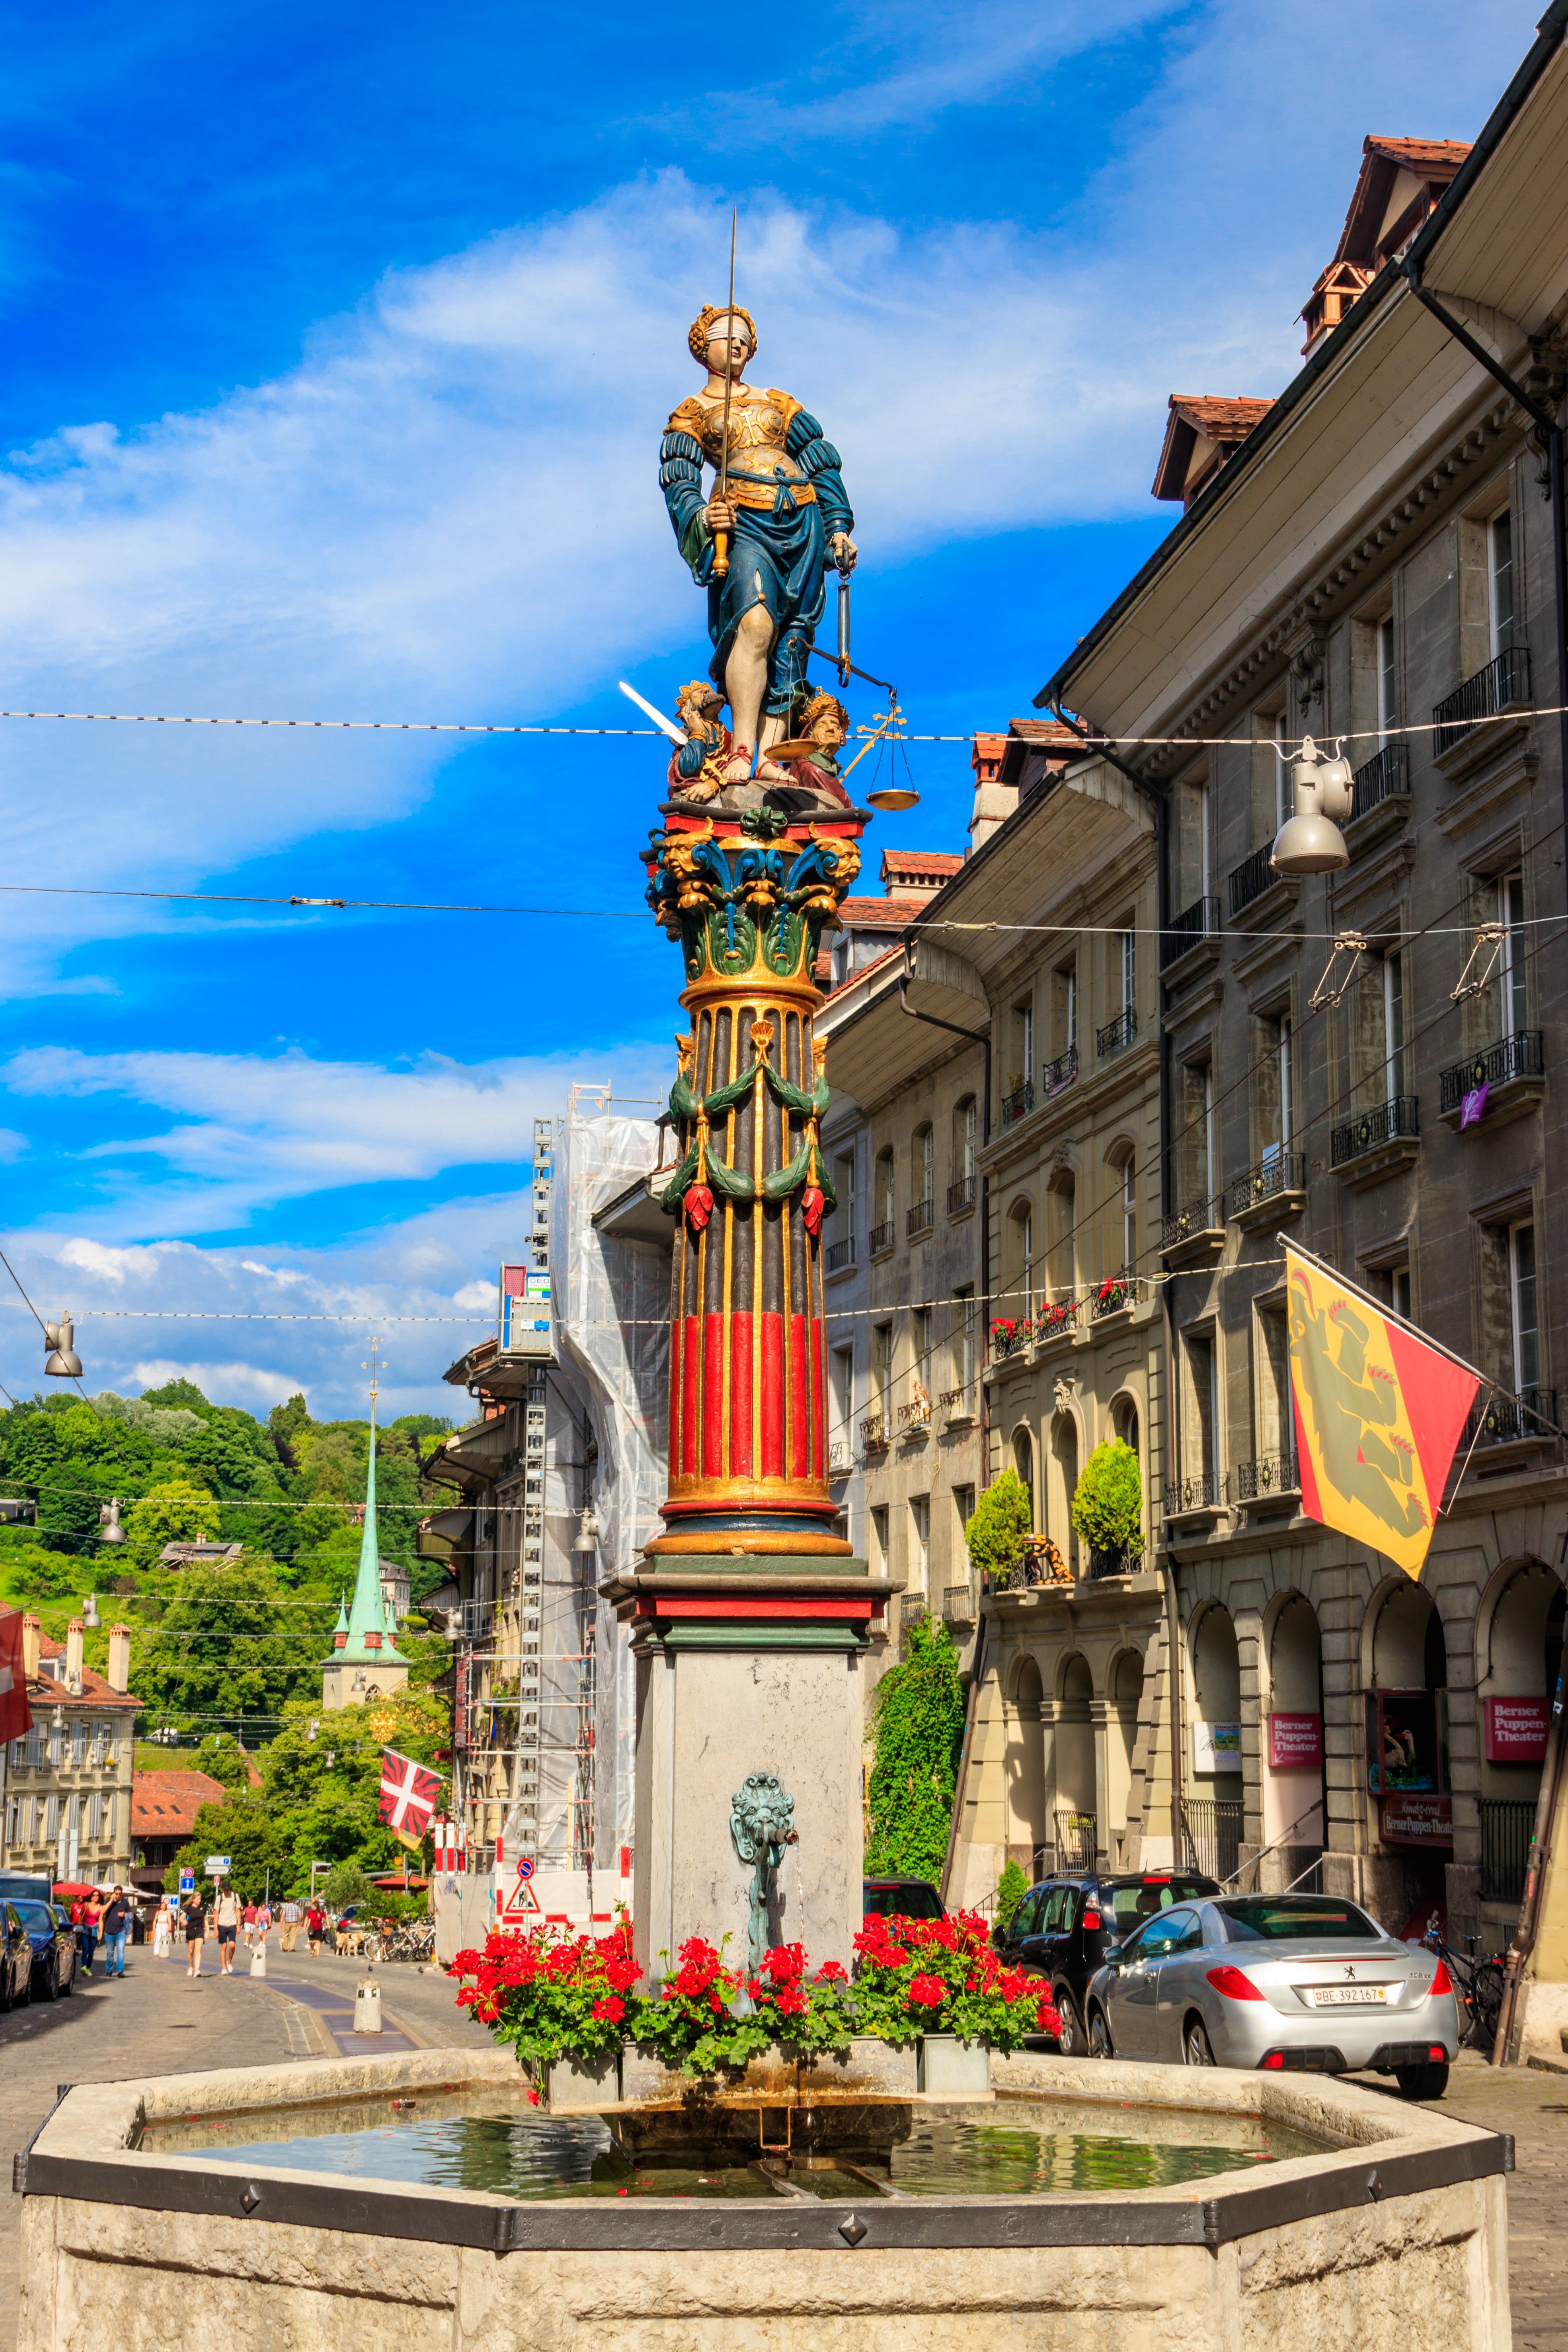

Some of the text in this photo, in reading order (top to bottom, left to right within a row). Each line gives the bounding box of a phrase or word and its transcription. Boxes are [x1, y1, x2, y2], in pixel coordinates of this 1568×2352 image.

[1494, 1705, 1539, 1716] Berner
[1274, 1720, 1313, 1730] Berner
[1494, 1718, 1547, 1730] Puppen-
[1274, 1730, 1319, 1742] Puppen-
[1495, 1730, 1545, 1741] Theater
[1274, 1742, 1317, 1751] Theater
[1386, 1815, 1454, 1835] Berner Puppen-Theate
